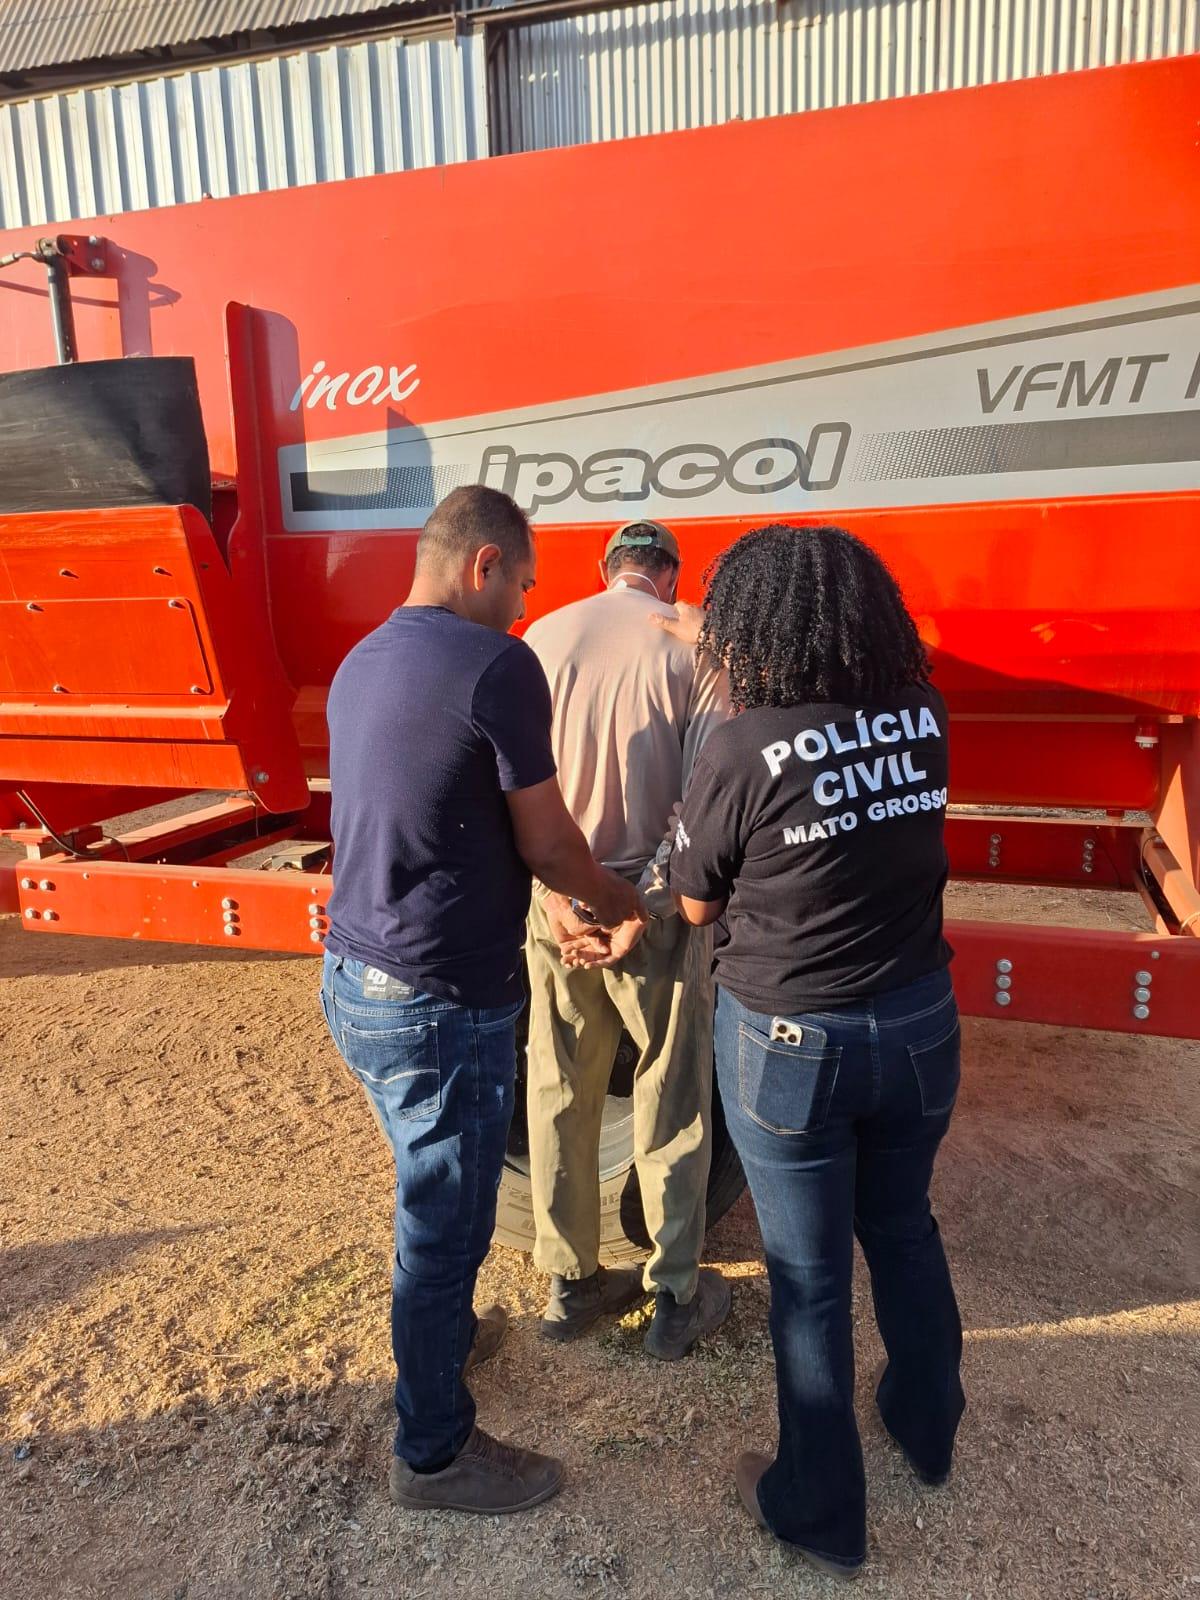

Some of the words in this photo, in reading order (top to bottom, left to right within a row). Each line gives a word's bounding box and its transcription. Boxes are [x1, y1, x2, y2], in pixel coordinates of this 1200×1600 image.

[290, 360, 421, 412] inox
[976, 353, 1170, 414] VFMT
[478, 422, 852, 517] ipacol
[760, 706, 942, 778] POLÍCIA
[812, 751, 928, 807] CIVIL
[782, 811, 858, 846] MATO
[866, 787, 948, 822] GROSSO
